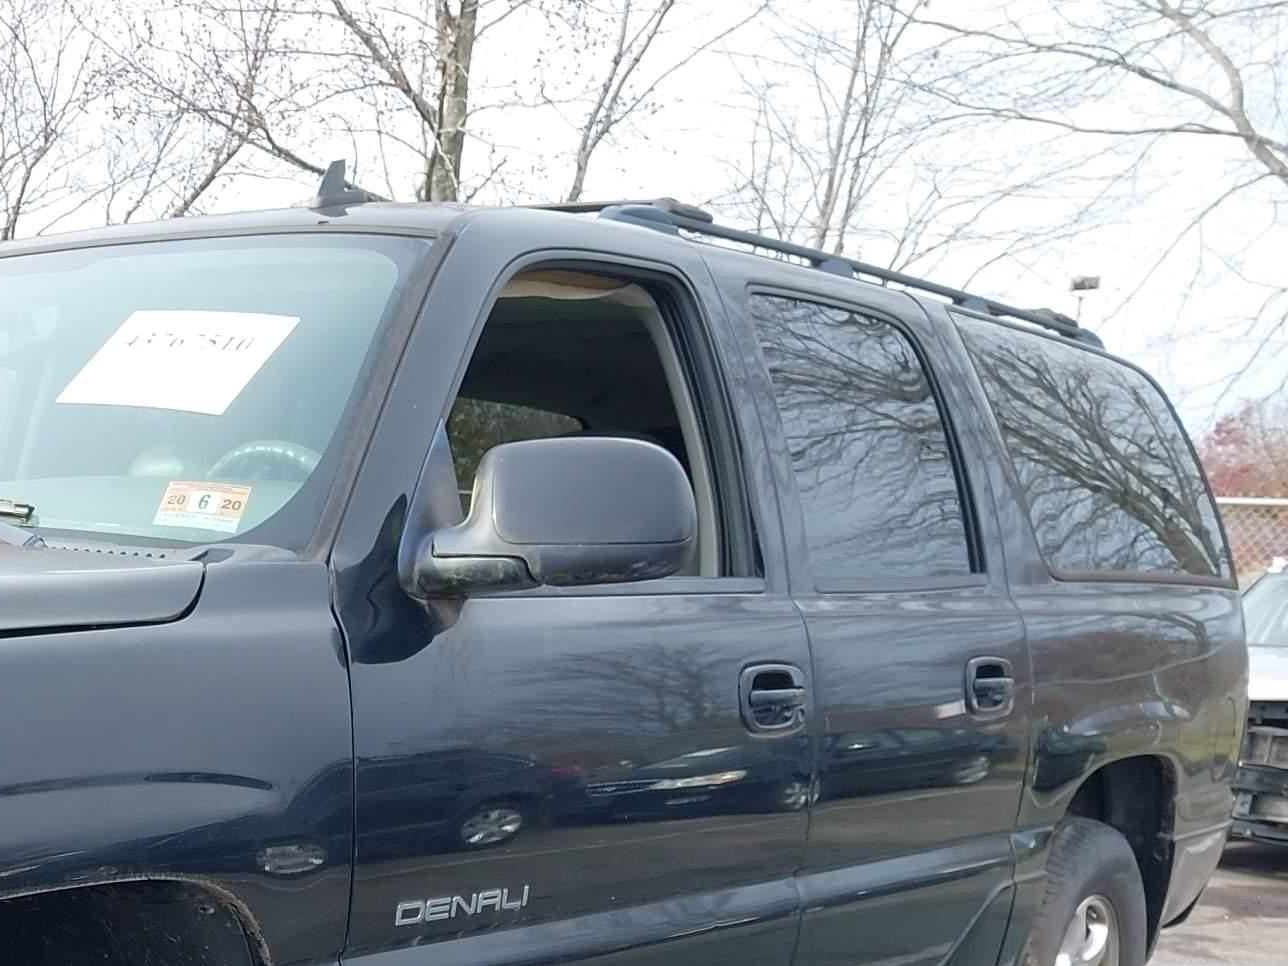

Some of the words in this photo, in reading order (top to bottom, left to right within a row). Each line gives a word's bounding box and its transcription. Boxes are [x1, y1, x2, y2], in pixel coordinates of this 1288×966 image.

[168, 495, 187, 505] 20
[198, 494, 212, 510] 6
[221, 499, 242, 511] 20
[395, 885, 530, 927] DENALI
